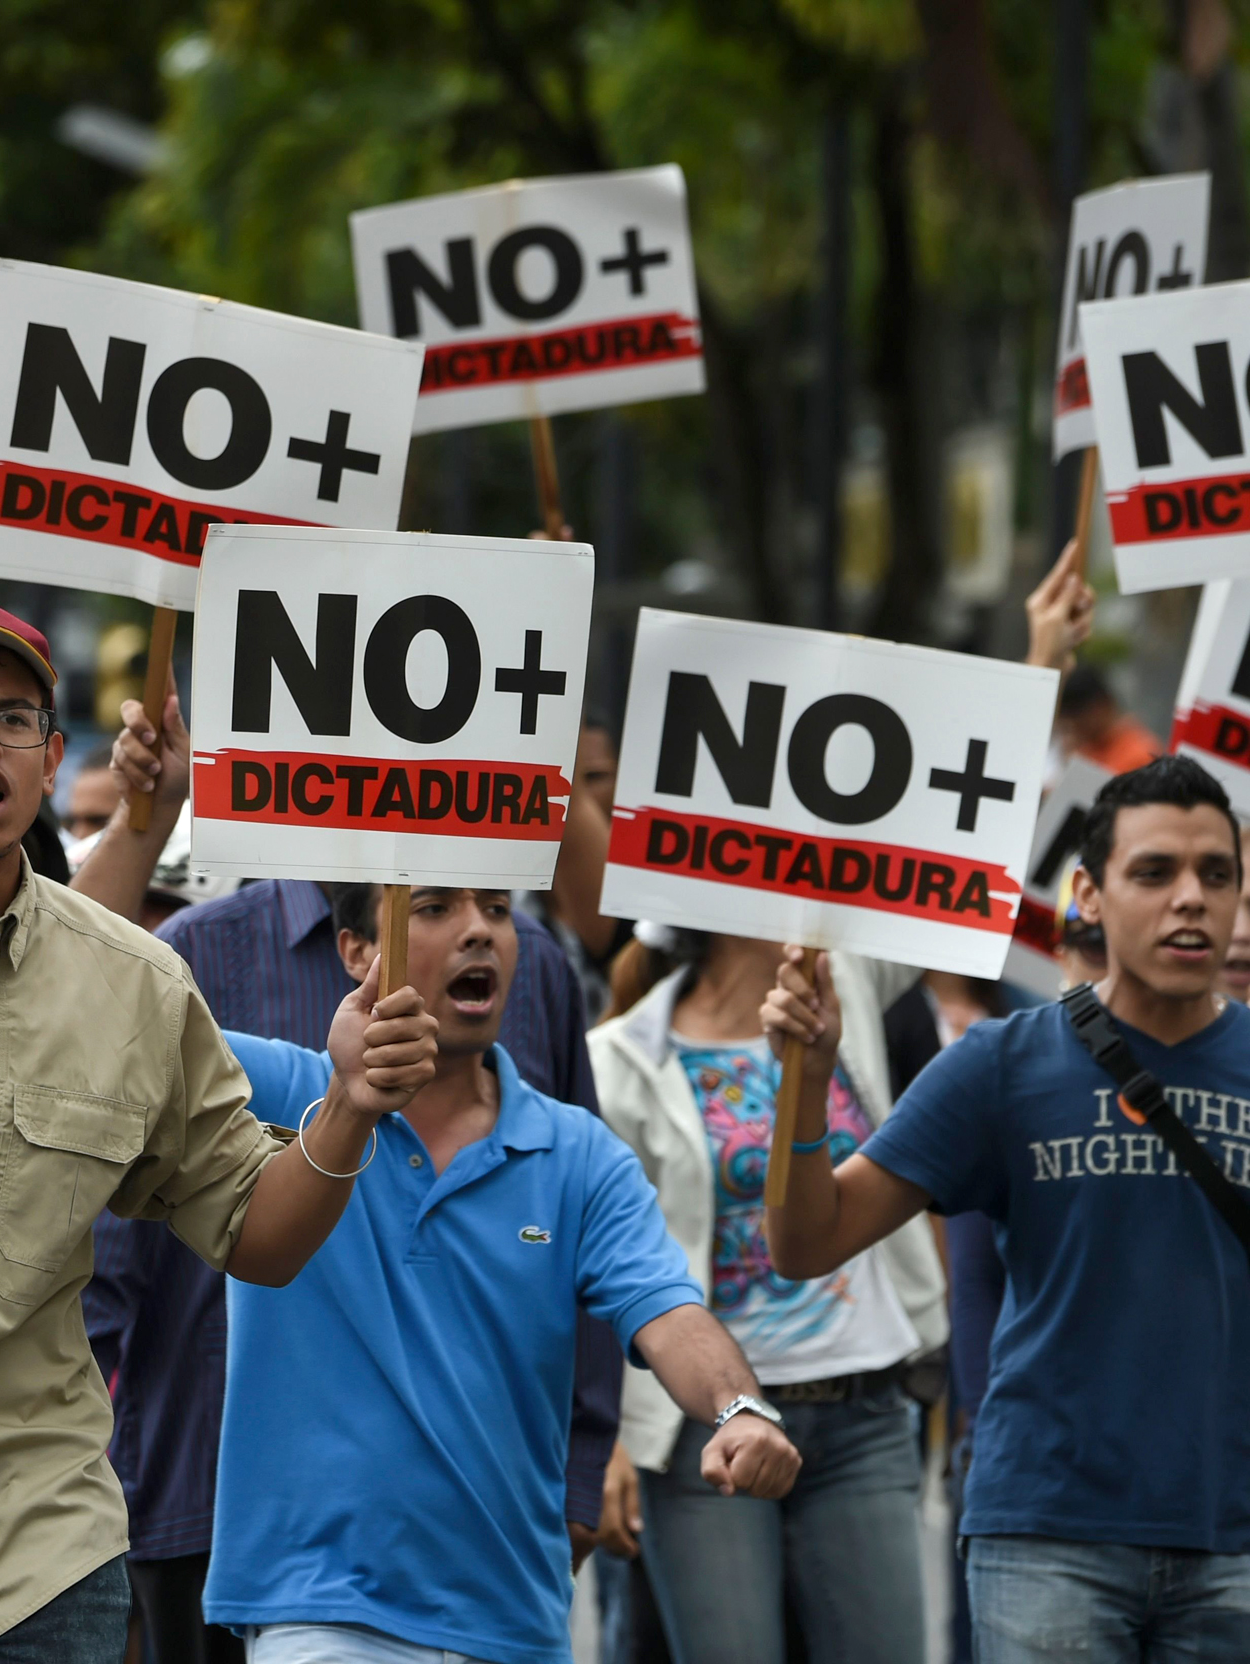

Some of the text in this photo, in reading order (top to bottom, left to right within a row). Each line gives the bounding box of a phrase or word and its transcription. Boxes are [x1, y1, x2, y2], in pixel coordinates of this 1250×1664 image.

[421, 321, 676, 387] ICTADURA
[1, 473, 248, 556] DICTAD
[231, 760, 551, 826] DICTADURA
[646, 819, 991, 919] DICTADURA
[1093, 1088, 1113, 1128] I
